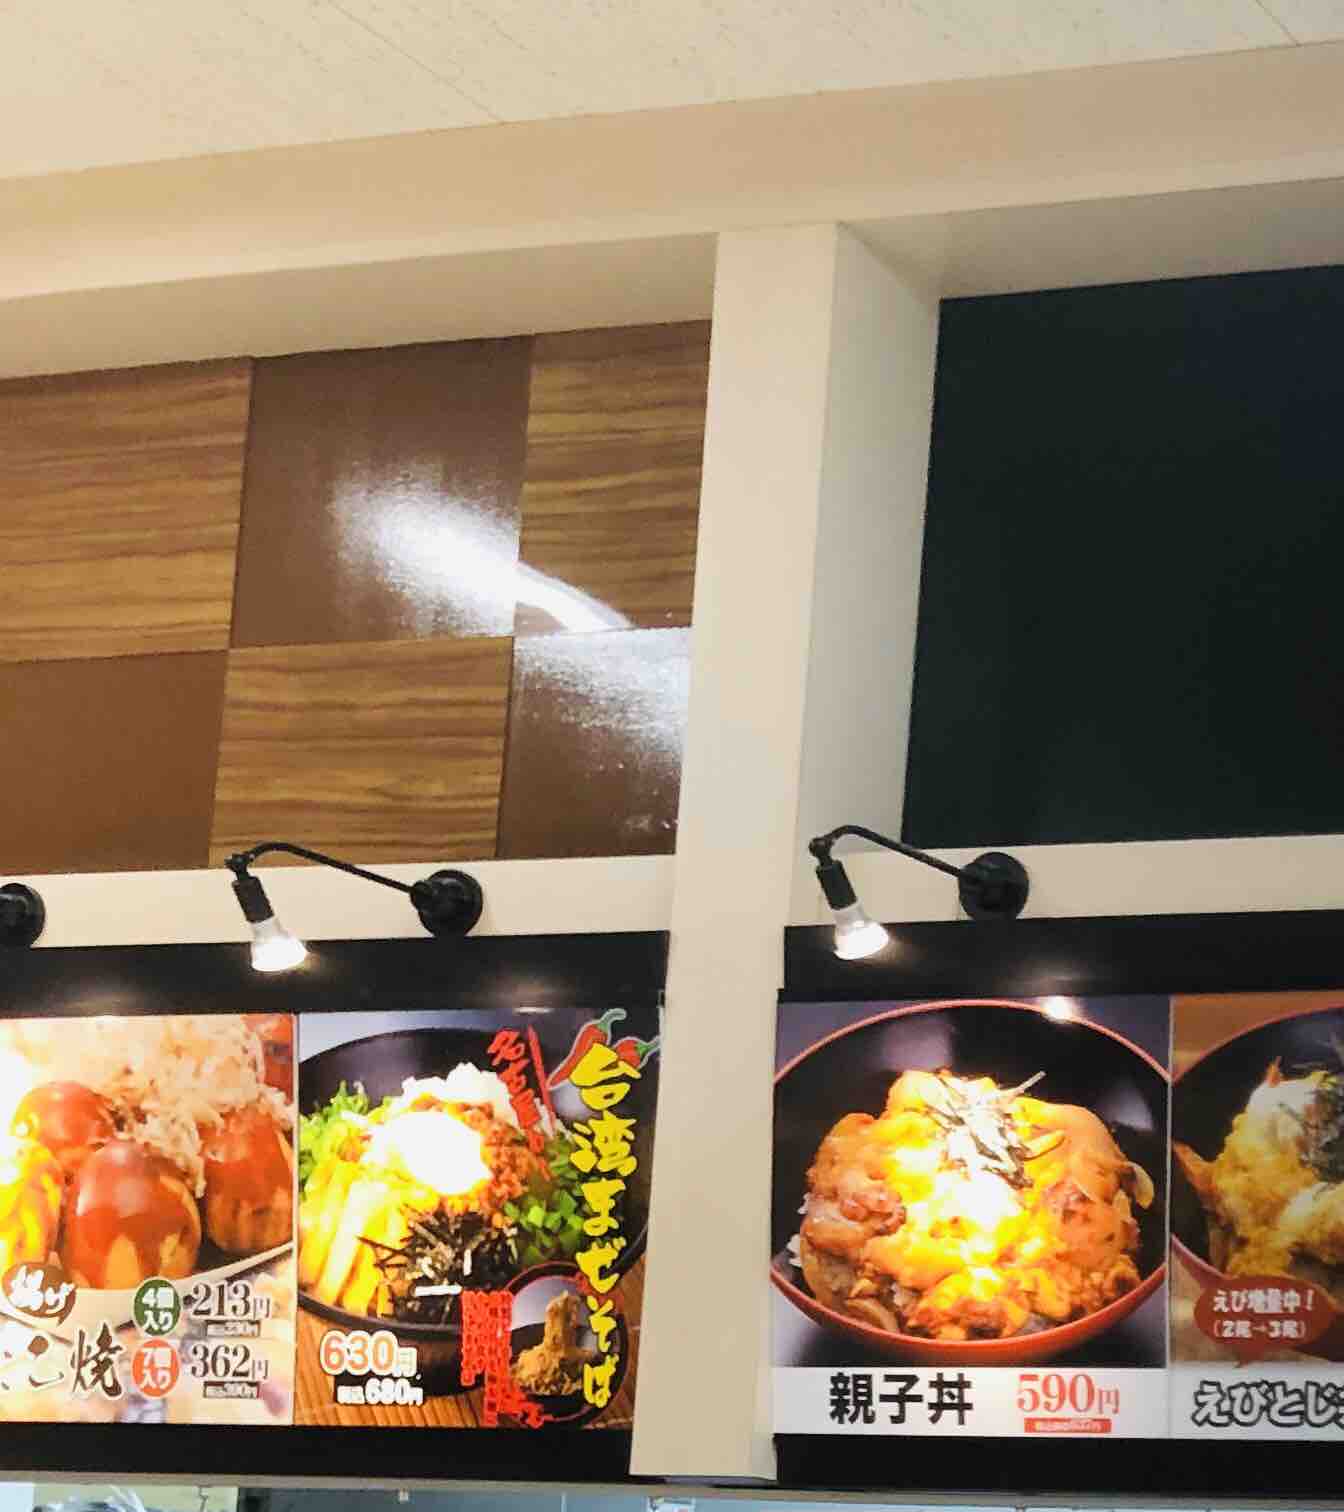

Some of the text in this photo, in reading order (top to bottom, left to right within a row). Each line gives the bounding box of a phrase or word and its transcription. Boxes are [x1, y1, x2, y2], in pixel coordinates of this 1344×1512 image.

[568, 1042, 641, 1409] 台湾まぜそば
[192, 1282, 270, 1319] 213円
[191, 1344, 269, 1379] 362円
[829, 1372, 974, 1426] 親子丼
[1016, 1373, 1120, 1415] 590円
